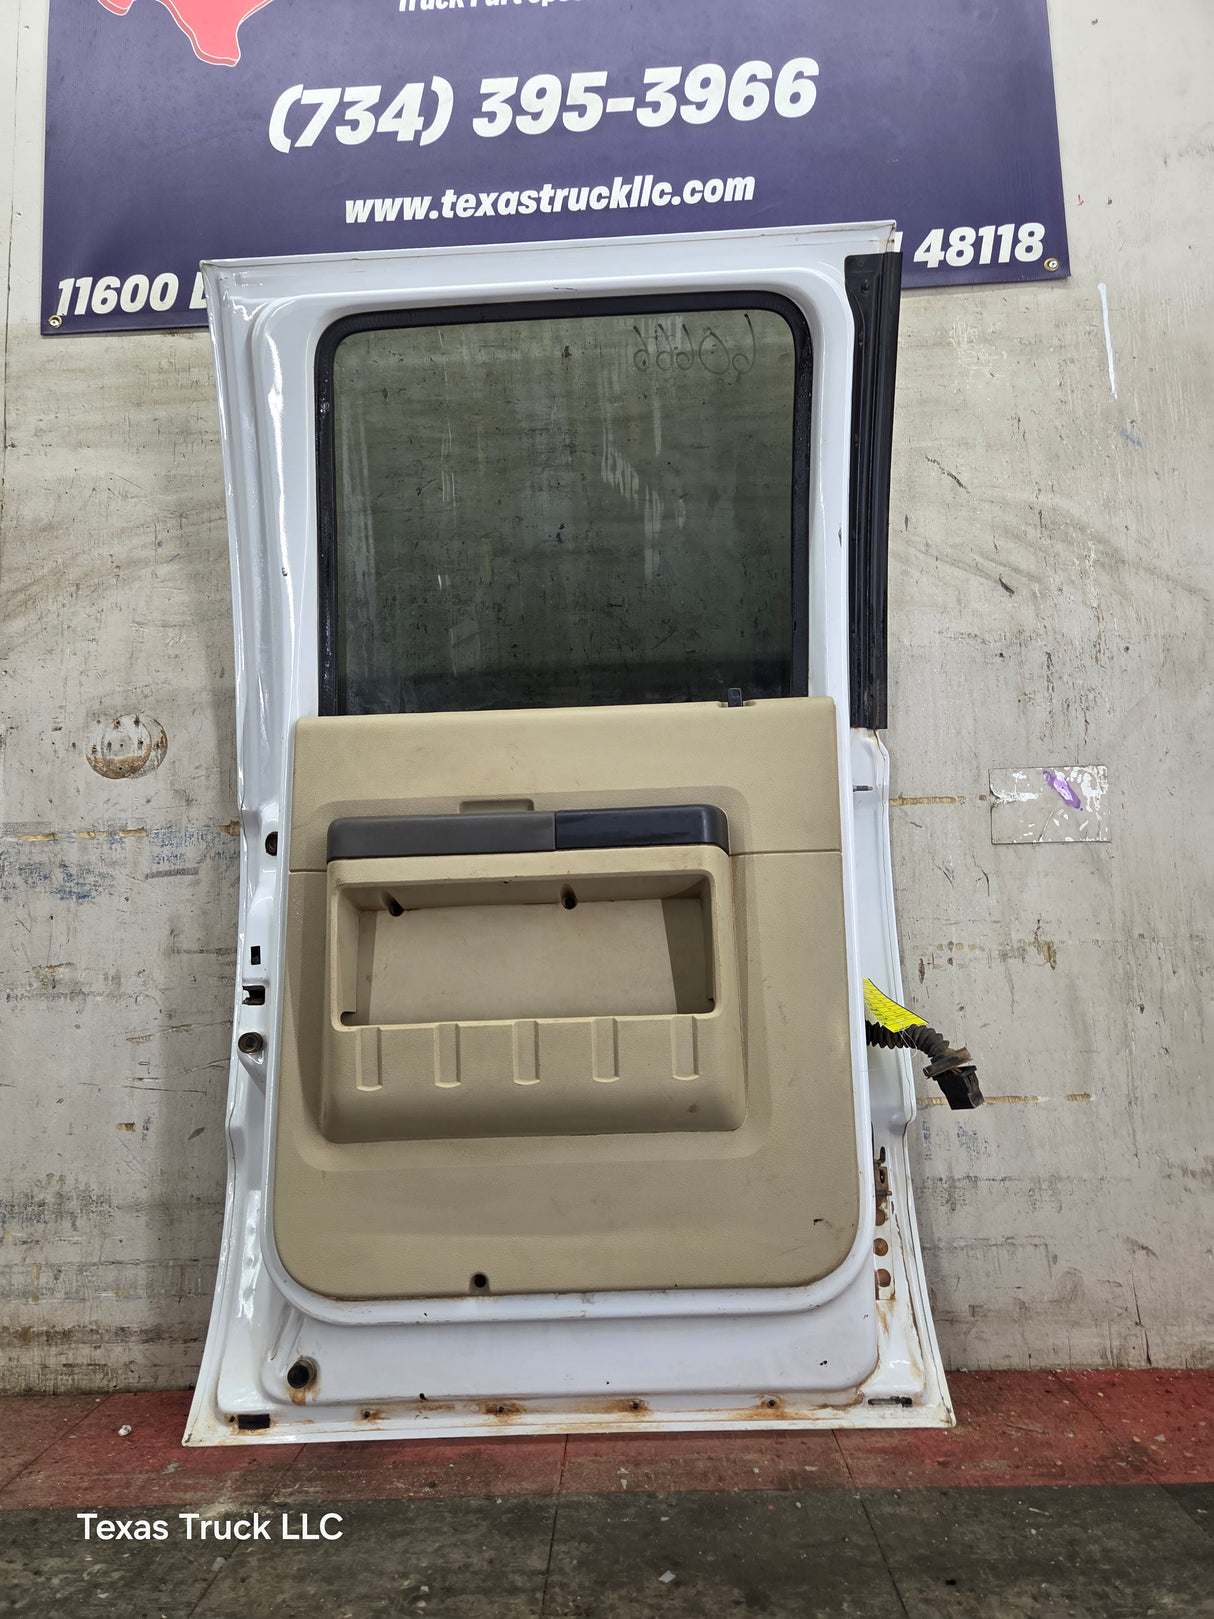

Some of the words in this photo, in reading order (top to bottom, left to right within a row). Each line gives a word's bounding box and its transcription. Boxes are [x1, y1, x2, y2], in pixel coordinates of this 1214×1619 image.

[268, 75, 454, 154] (734)
[472, 56, 820, 138] 395-3966
[345, 174, 756, 224] www.texastruckllc.com
[57, 272, 179, 317] 11600
[913, 222, 1046, 269] 48118
